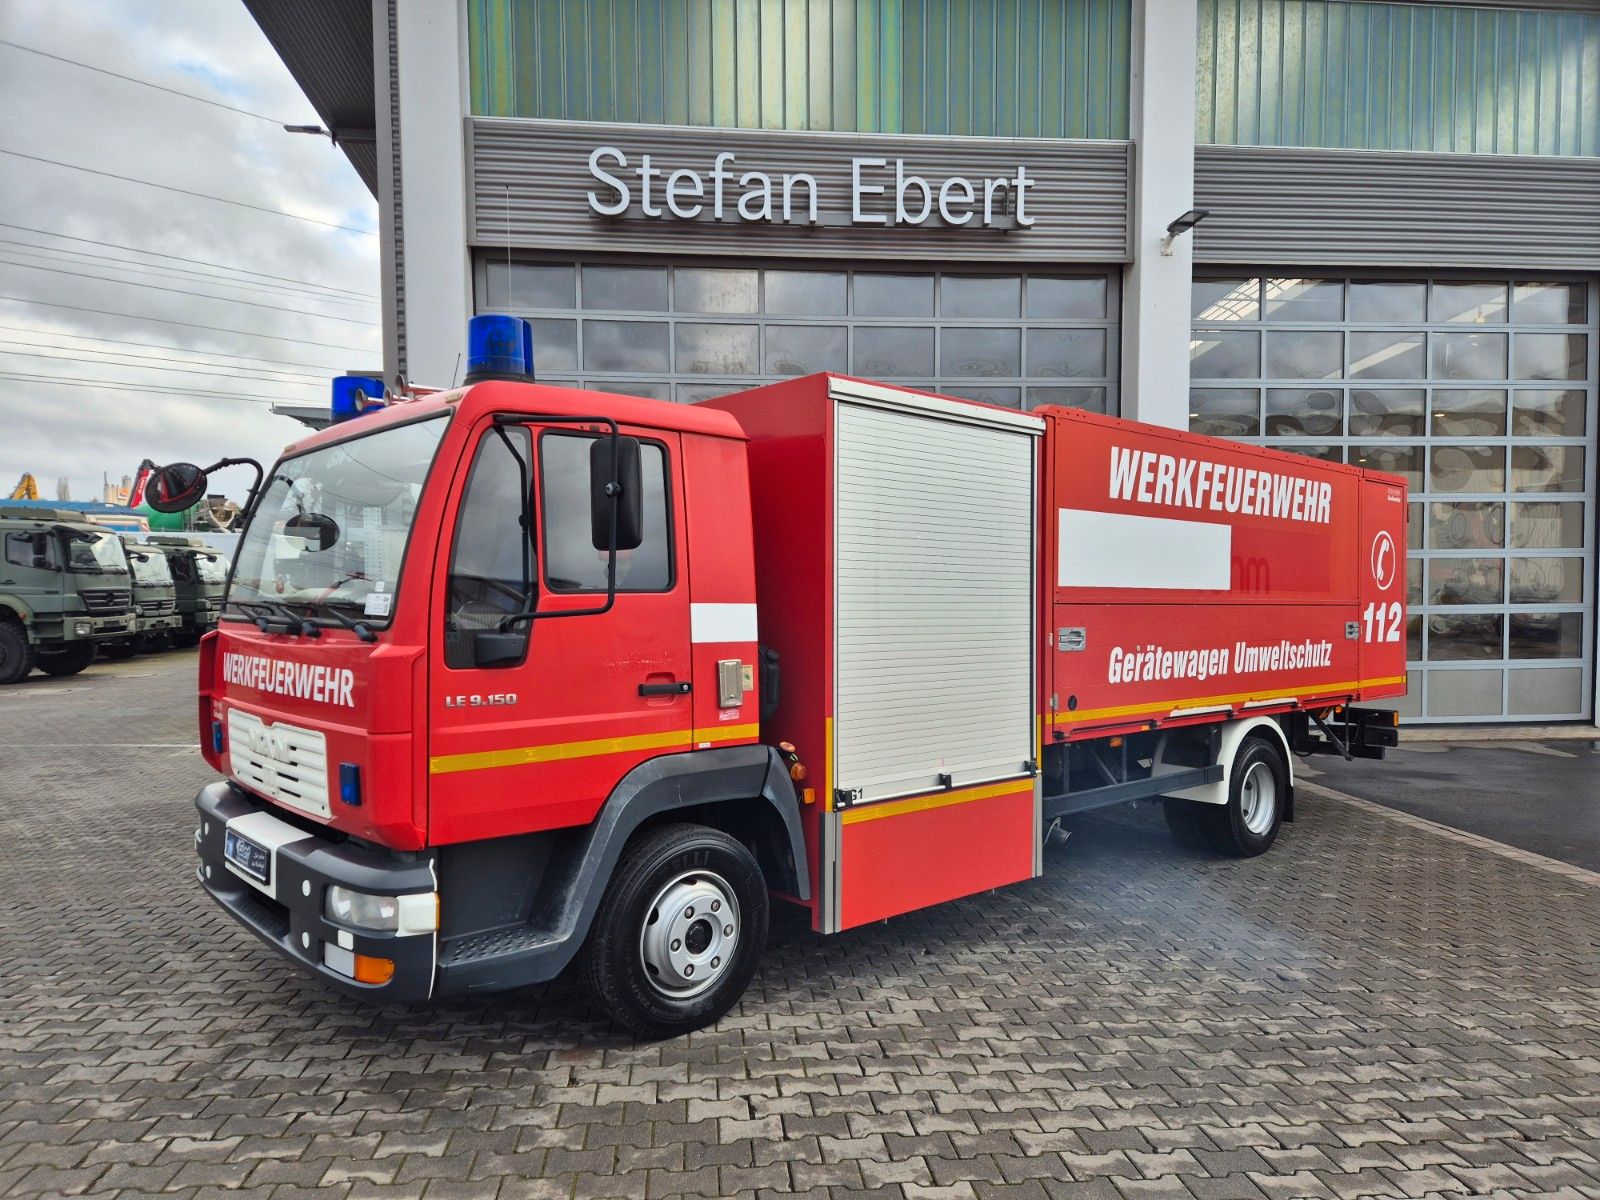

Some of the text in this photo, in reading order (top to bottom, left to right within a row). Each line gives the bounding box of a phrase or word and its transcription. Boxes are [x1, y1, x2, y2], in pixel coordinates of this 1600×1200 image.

[587, 146, 1036, 227] Stefan Ebert
[1109, 446, 1332, 524] WERKFEUERWEHR
[1363, 602, 1402, 643] 112
[223, 652, 355, 708] WERKFEUERWEHR
[1108, 639, 1333, 684] Gerätewagen Umweltschutz
[445, 693, 518, 707] LE 9.150
